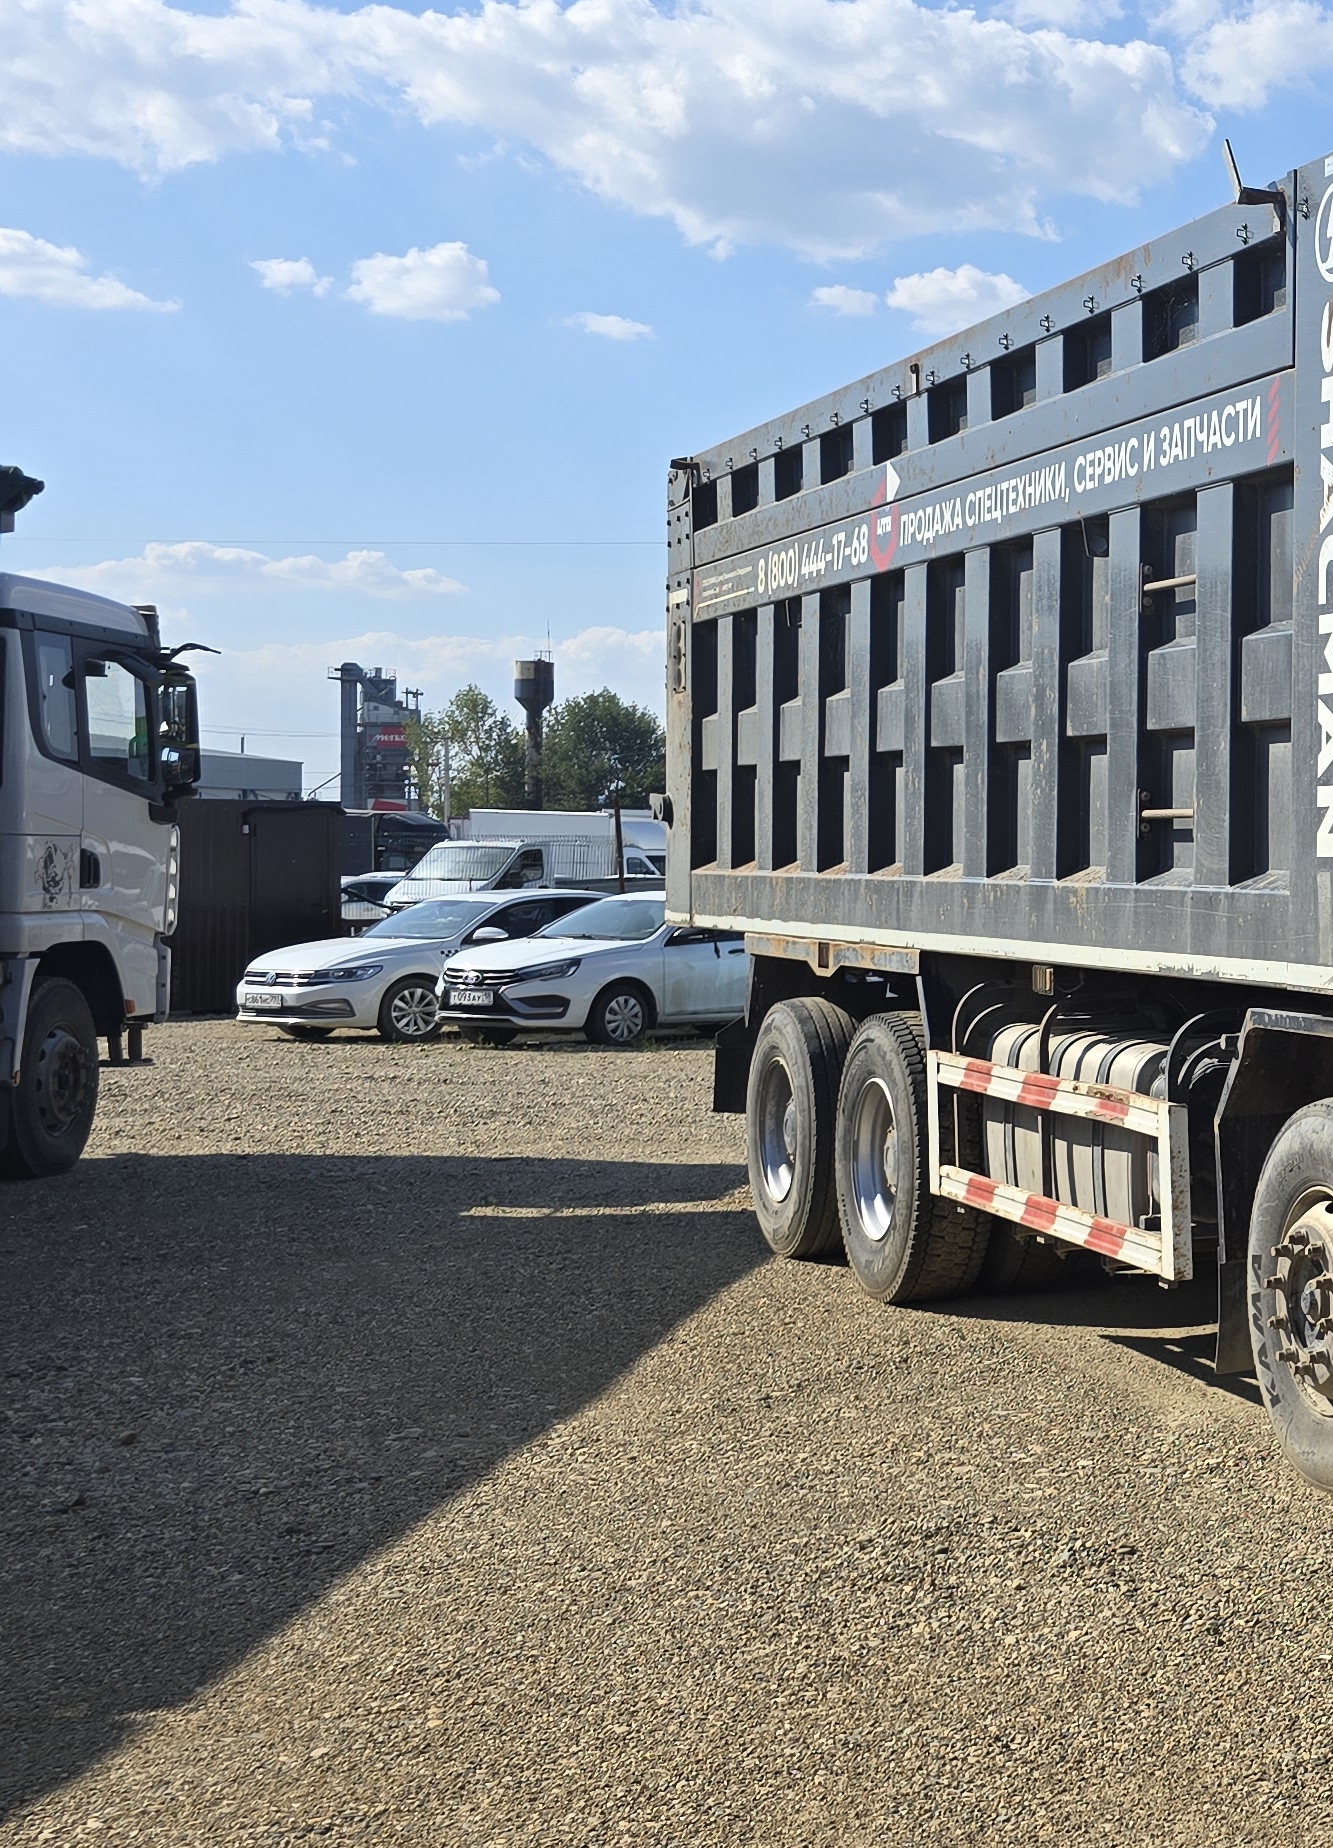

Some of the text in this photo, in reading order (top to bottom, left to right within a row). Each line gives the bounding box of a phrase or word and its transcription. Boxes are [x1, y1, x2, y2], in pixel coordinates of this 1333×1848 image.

[900, 395, 1261, 546] ПРОДАЖА СПЕЦТЕХНИКИ, СЕРВИС И ЗАПЧАСТИ
[757, 558, 766, 594] 8
[768, 542, 799, 595] (800)
[801, 523, 869, 580] 444-17-68
